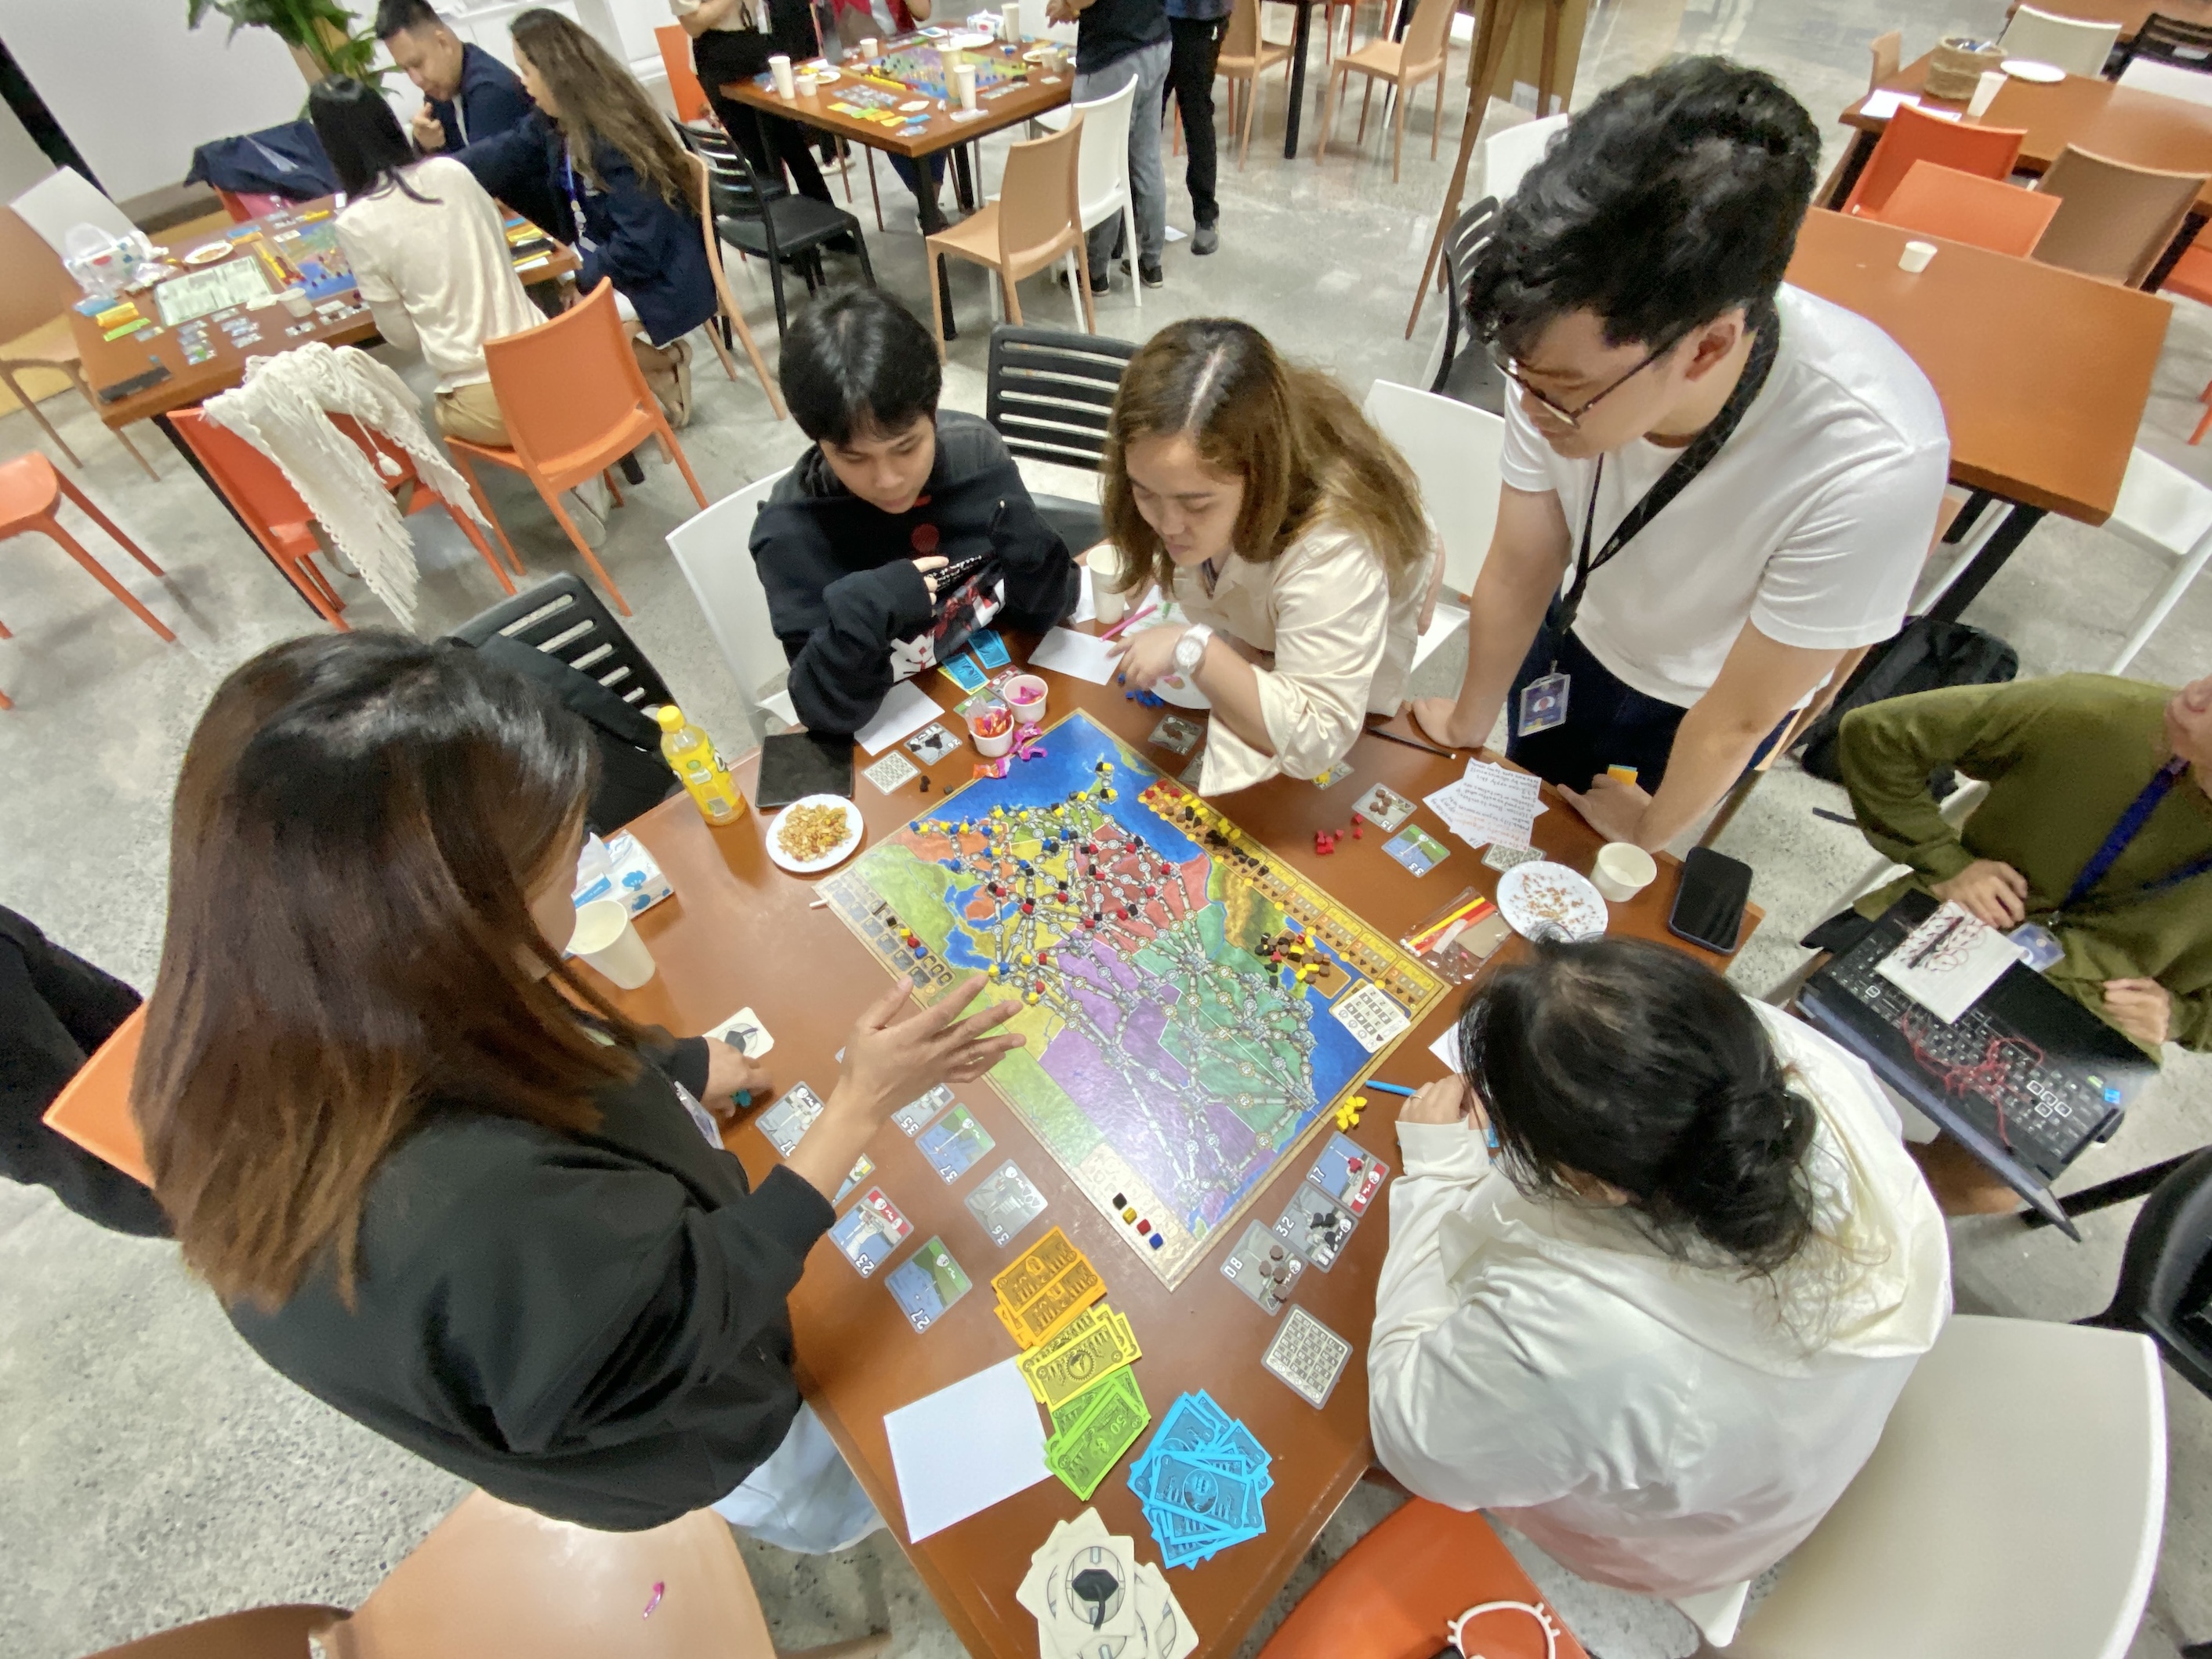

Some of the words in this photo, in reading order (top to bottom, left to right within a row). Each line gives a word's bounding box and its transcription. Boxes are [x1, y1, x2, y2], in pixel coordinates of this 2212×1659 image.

[1475, 774, 1488, 783] this
[1380, 820, 1394, 831] 15
[1407, 862, 1424, 875] 33
[1241, 1064, 1251, 1074] 27
[1238, 1096, 1249, 1106] 23
[901, 1115, 919, 1134] 35
[1257, 1136, 1268, 1146] 24
[940, 1163, 958, 1182] 37
[1309, 1166, 1326, 1184] 17
[991, 1224, 1010, 1244] 36
[1275, 1215, 1295, 1237] 32
[854, 1252, 875, 1275] 23
[1224, 1256, 1242, 1278] 08
[910, 1308, 930, 1330] 27
[1108, 1414, 1127, 1434] 50
[1130, 1416, 1142, 1428] 50
[1058, 1455, 1070, 1469] 50
